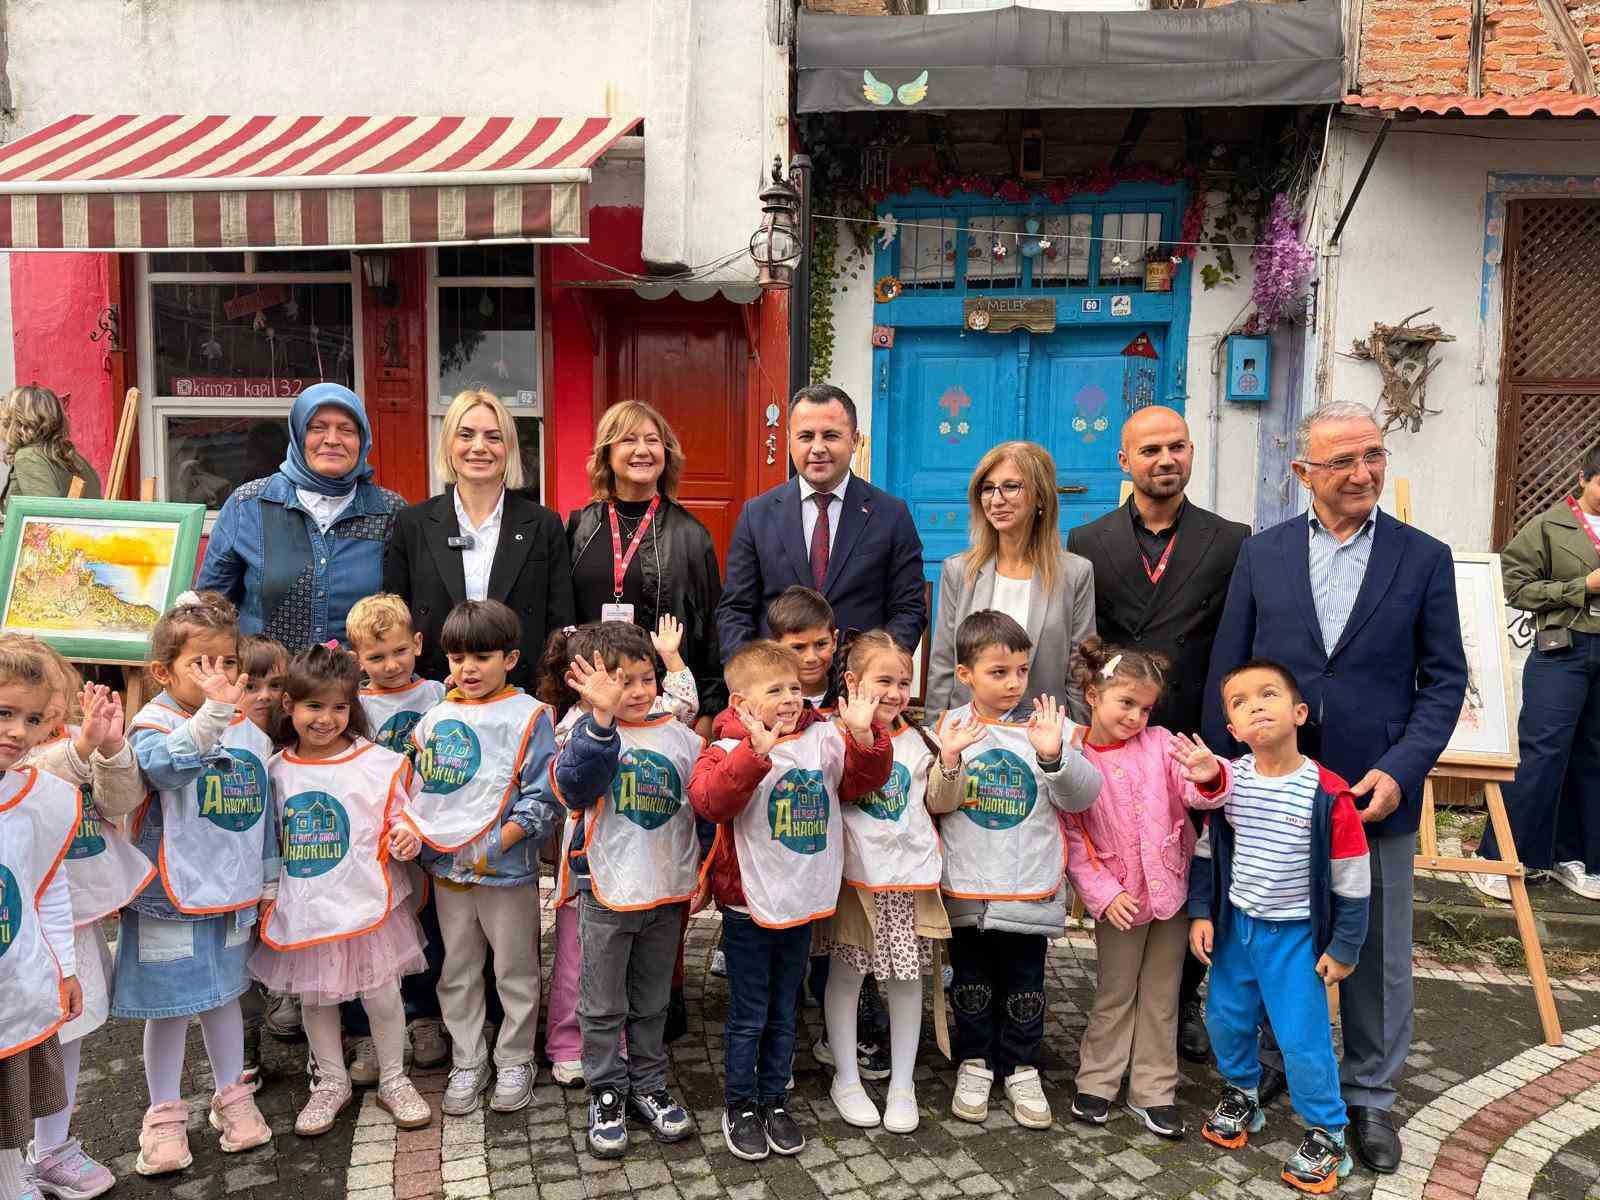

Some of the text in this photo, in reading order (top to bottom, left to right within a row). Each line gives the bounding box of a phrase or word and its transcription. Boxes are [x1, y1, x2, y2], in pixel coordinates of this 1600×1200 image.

[986, 300, 1027, 313] MELEK
[1085, 300, 1097, 310] 60
[279, 379, 303, 397] 32
